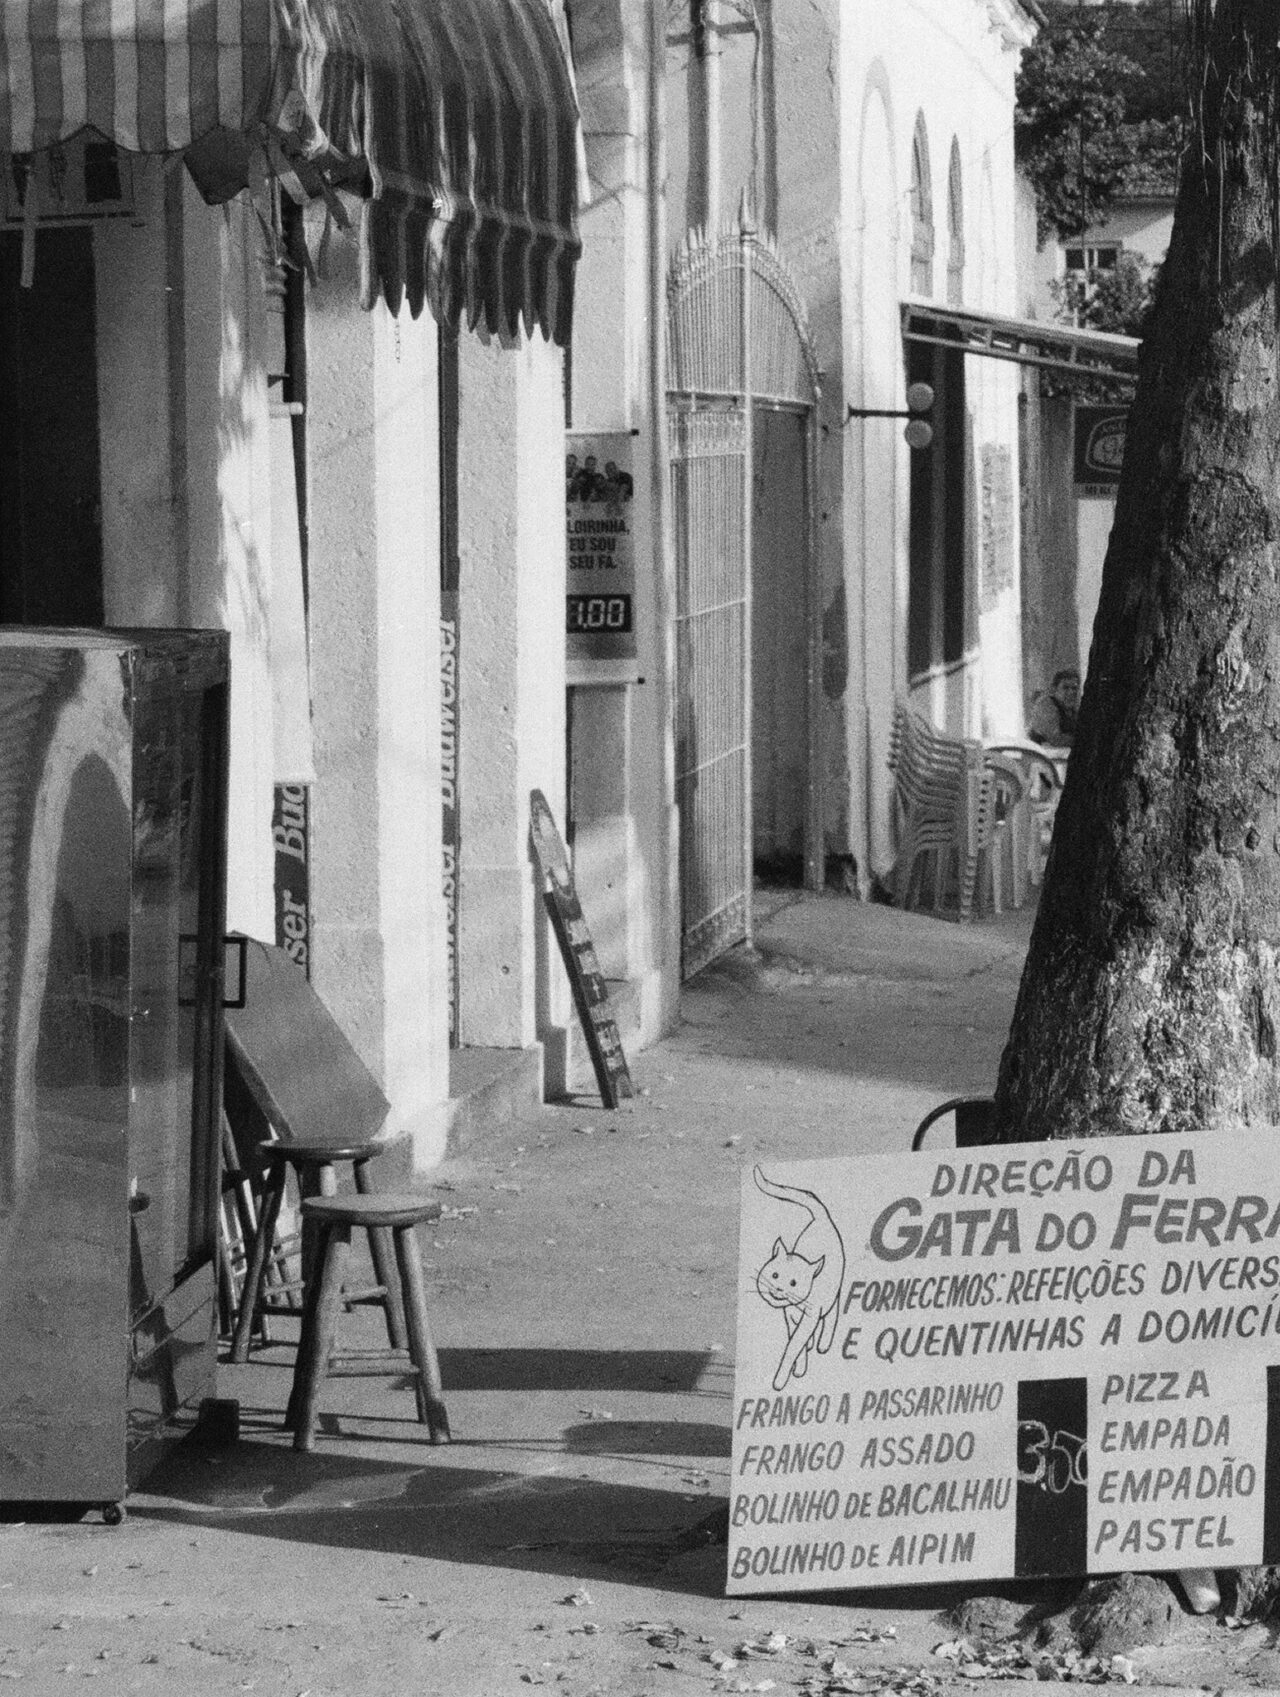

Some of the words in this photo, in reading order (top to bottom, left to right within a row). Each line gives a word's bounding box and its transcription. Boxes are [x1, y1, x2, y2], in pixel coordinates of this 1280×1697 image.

[569, 537, 585, 551] EU
[590, 537, 616, 551] SOU
[569, 555, 594, 569] SEU
[930, 1149, 1113, 1198] DIREÇÃO
[1137, 1149, 1197, 1188] DA
[870, 1197, 1021, 1262] GATA
[1035, 1212, 1097, 1252] DO
[1007, 1259, 1146, 1304] REFEIÇÕES
[841, 1327, 862, 1360] E
[875, 1315, 1086, 1363] QUENTINHAS
[1100, 1313, 1121, 1346] A
[736, 1394, 831, 1430] FRANGO
[835, 1392, 850, 1425] A
[858, 1381, 1004, 1421] PASSARINHO
[1102, 1369, 1210, 1405] PIZZA
[739, 1440, 845, 1476] FRANGO
[860, 1430, 976, 1469] ASSADO
[1100, 1414, 1230, 1453] EMPADA
[731, 1489, 840, 1527] BOLINHO
[843, 1491, 873, 1520] DE
[877, 1477, 1012, 1518] BACALHAU
[1098, 1456, 1256, 1504] EMPADÃO
[730, 1541, 846, 1579] BOLINHO
[850, 1543, 880, 1569] DE
[887, 1531, 976, 1567] AIPIM
[1094, 1514, 1235, 1555] PASTEL
